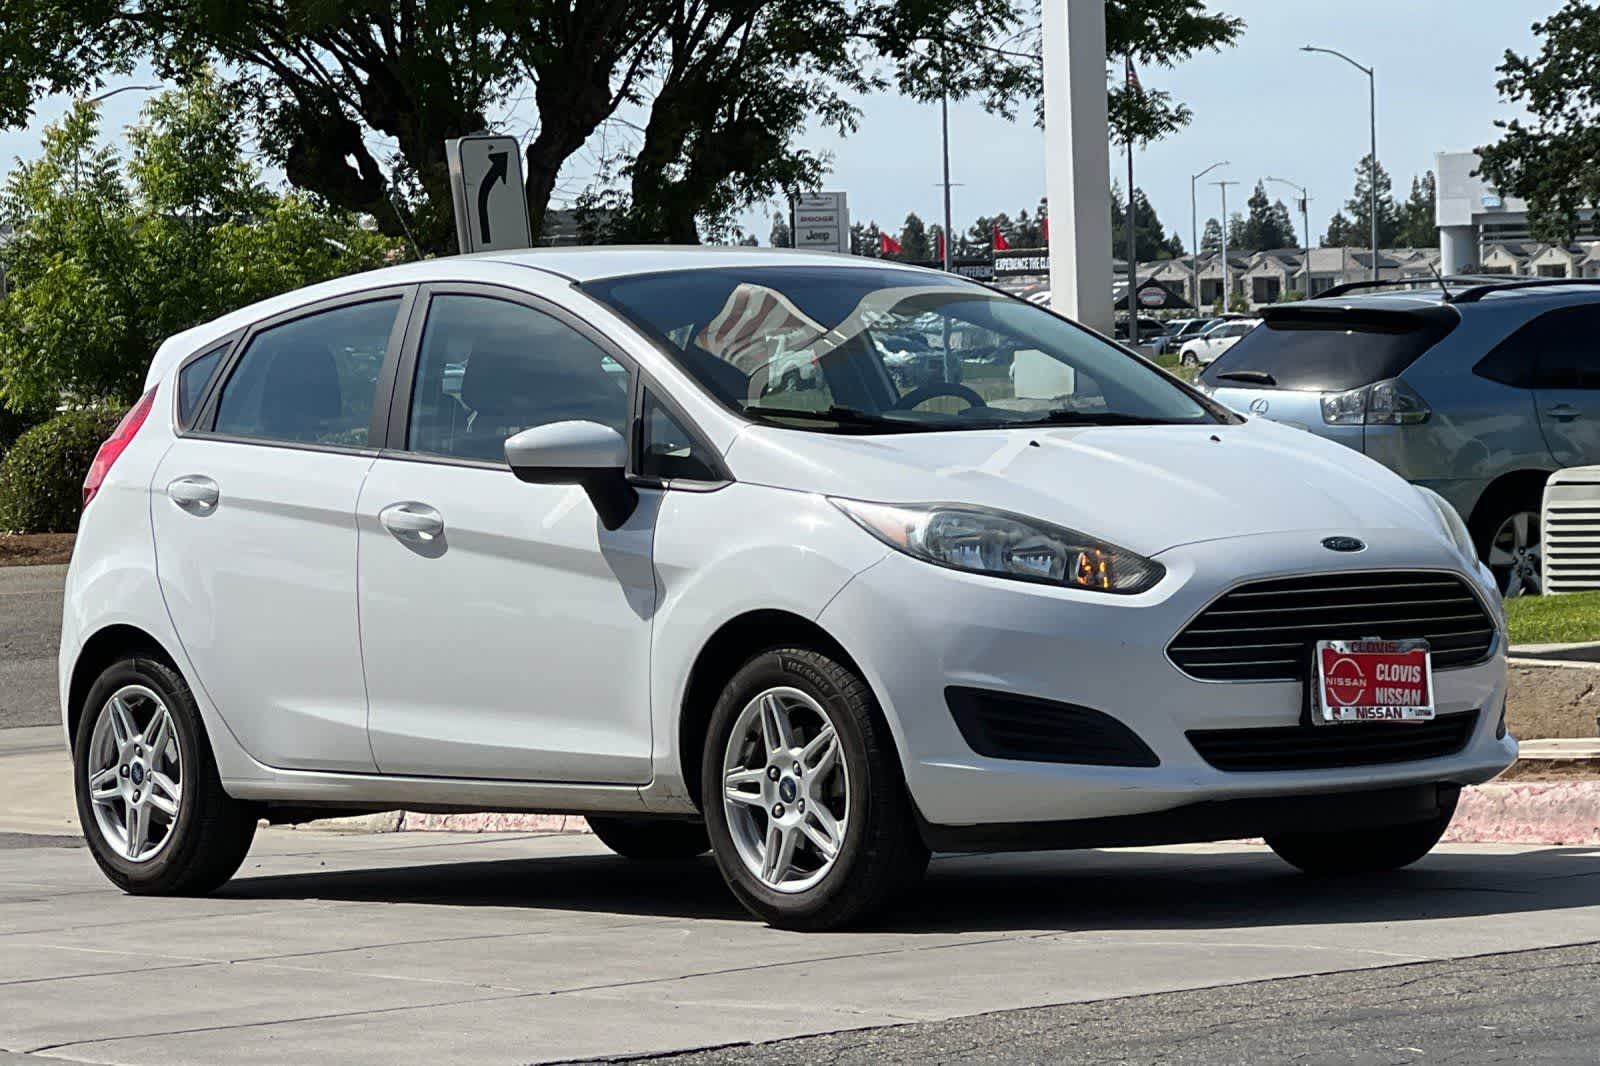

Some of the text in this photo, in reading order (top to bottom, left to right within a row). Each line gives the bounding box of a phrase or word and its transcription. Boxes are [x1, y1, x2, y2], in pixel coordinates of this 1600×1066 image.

[806, 229, 830, 241] Jeep
[995, 257, 1028, 271] EXPERIENCE
[1029, 257, 1040, 270] THE
[1375, 663, 1421, 683] CLOVIS
[1326, 677, 1367, 688] NISSAN
[1375, 687, 1421, 706] NISSAN
[1356, 707, 1403, 719] NISSAN
